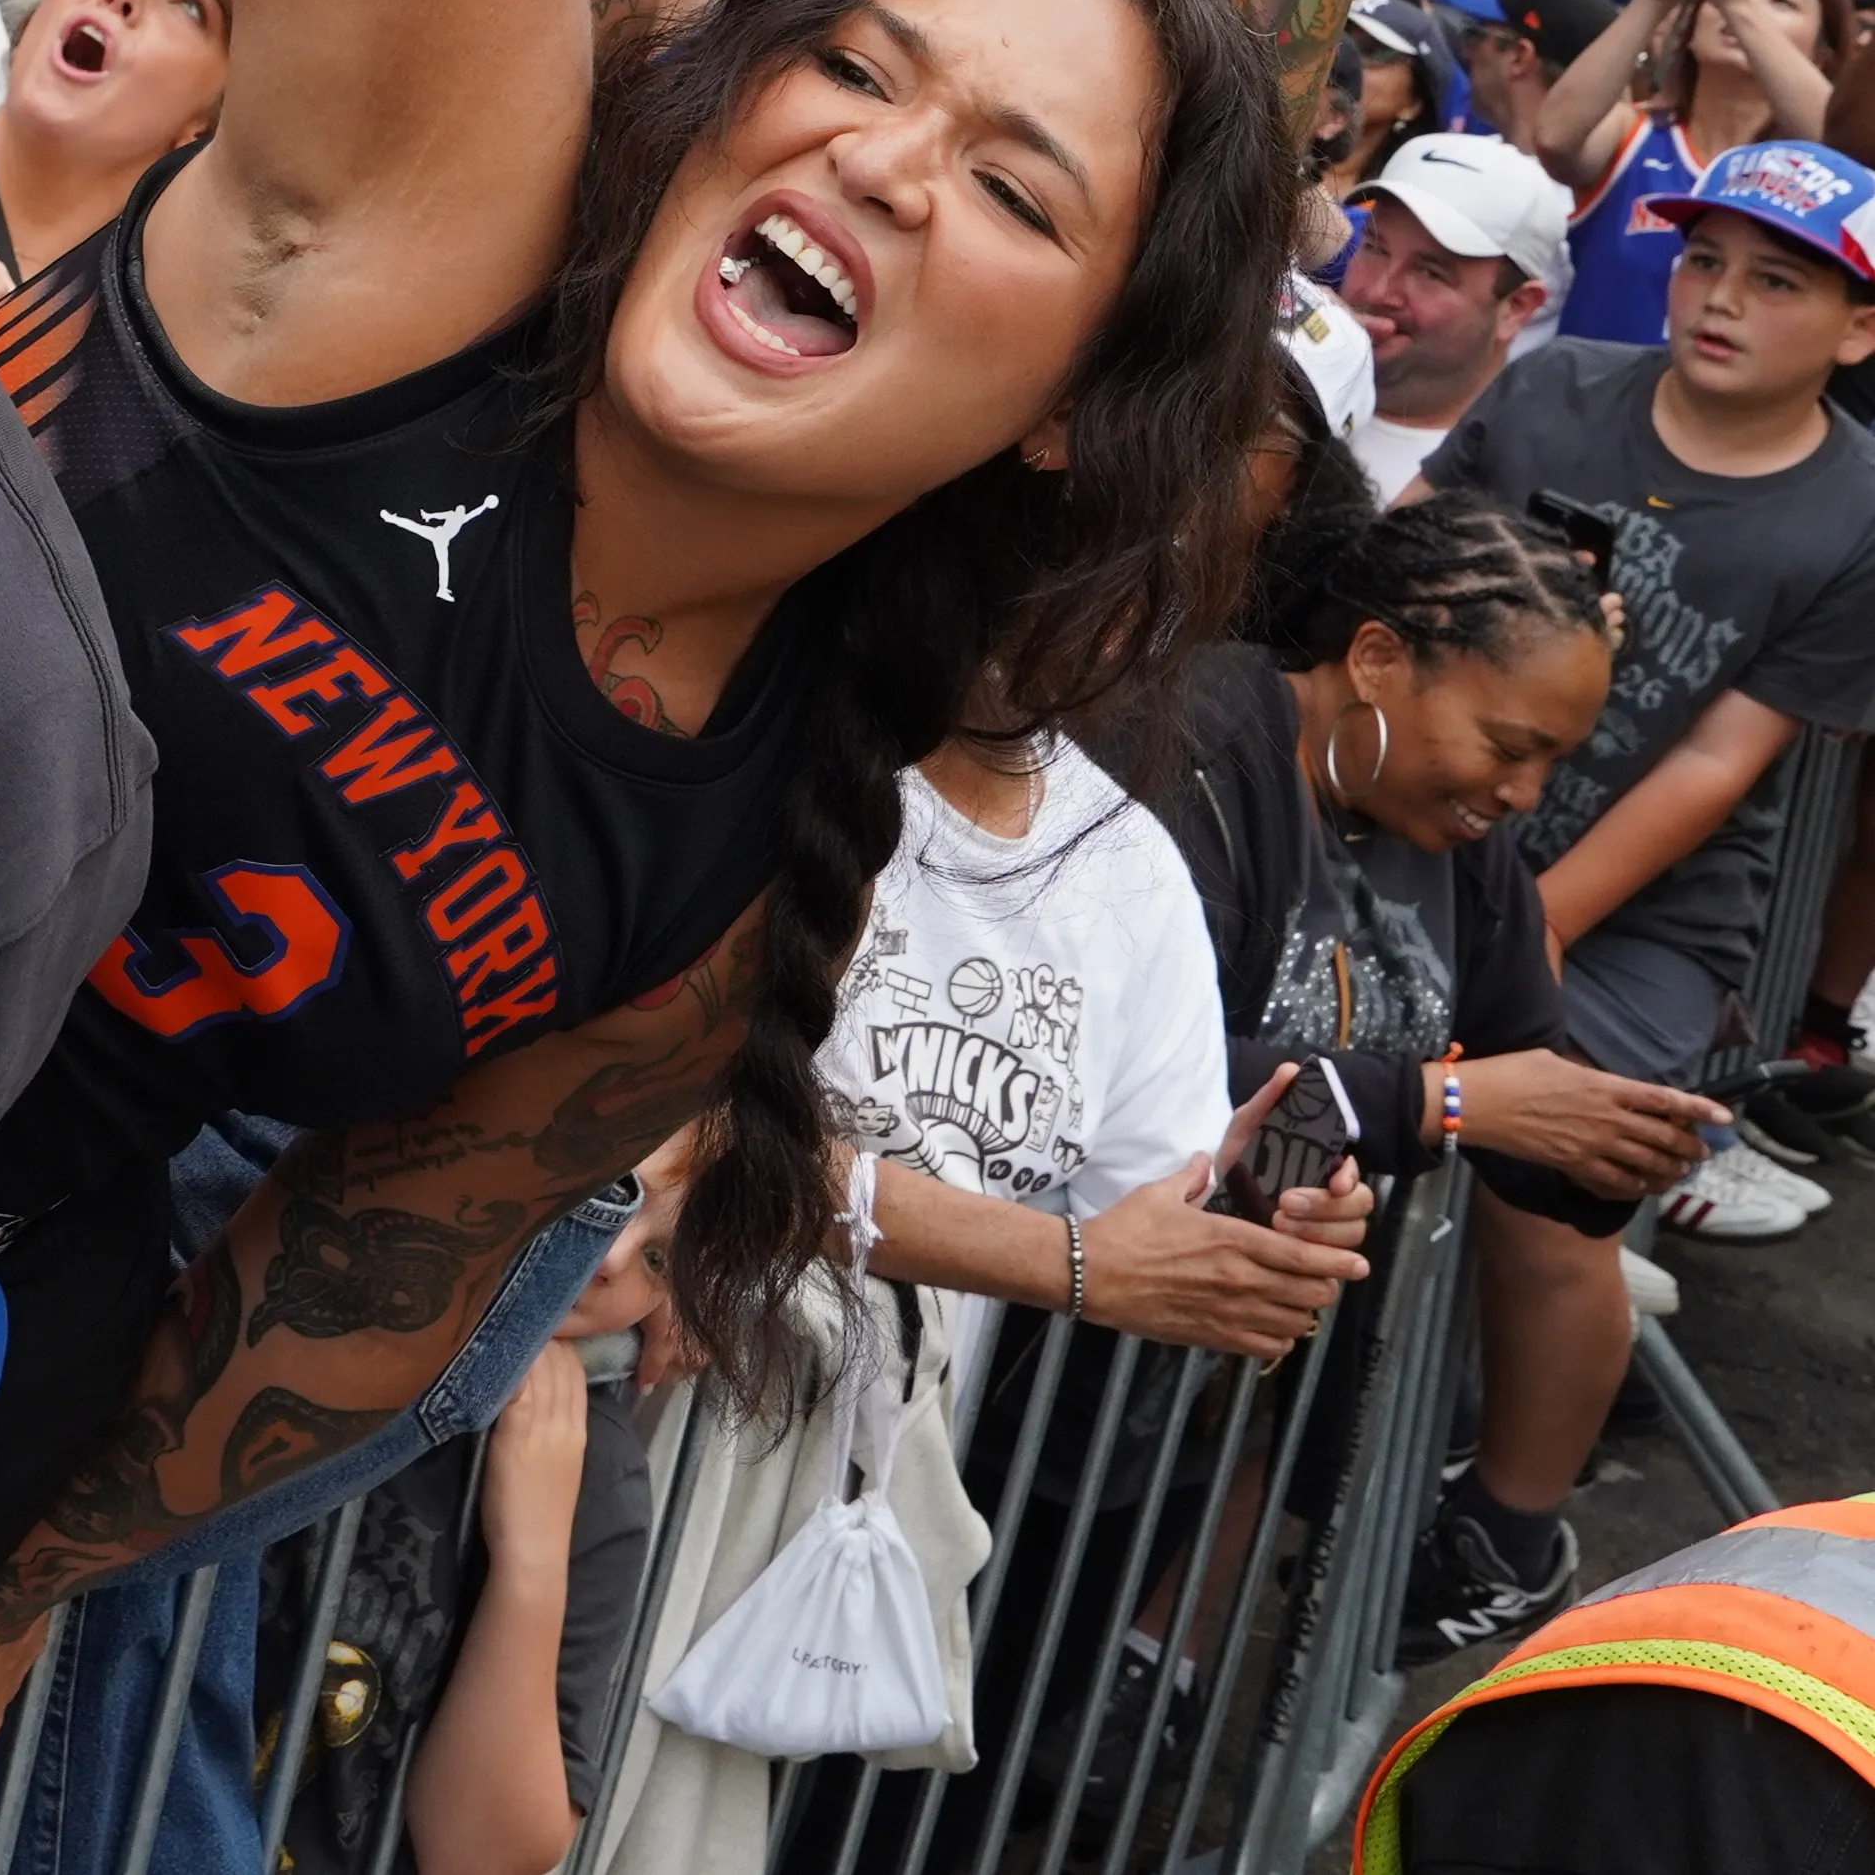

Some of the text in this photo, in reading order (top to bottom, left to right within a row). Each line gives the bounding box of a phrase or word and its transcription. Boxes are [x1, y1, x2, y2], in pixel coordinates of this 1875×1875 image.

[167, 584, 461, 809] NEW
[378, 780, 564, 1061] YORK
[85, 858, 353, 1043] 3
[1007, 963, 1055, 1008] BIG
[867, 1022, 1040, 1147] KNICKS
